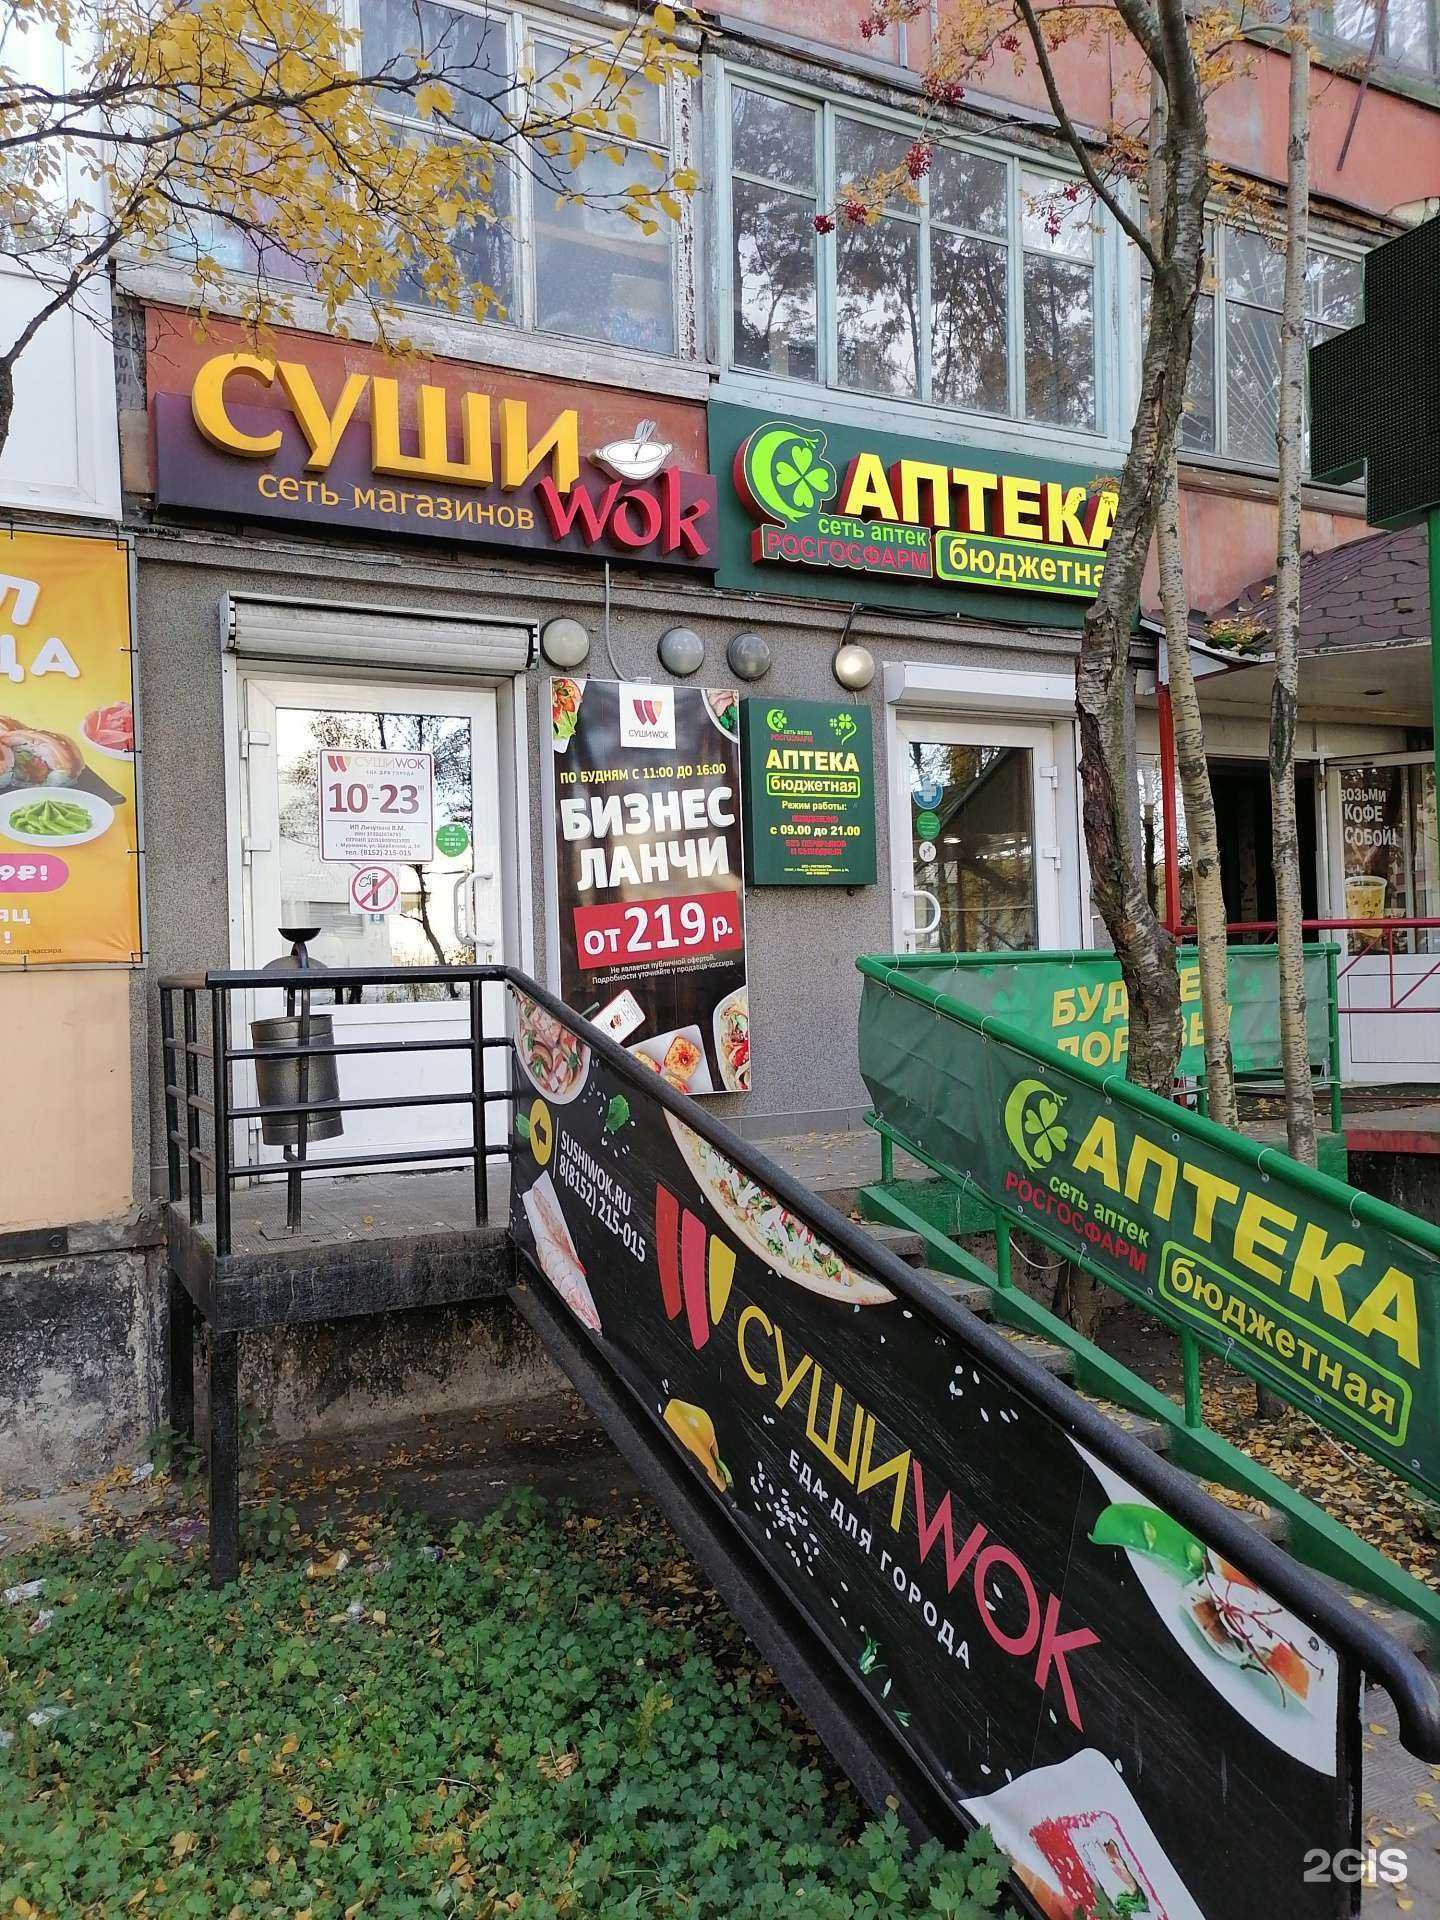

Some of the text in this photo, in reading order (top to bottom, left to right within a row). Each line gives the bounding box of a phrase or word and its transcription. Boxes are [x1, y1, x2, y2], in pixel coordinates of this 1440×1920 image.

[191, 353, 581, 494] СУШИ
[257, 469, 536, 531] сеть магазинов
[841, 452, 1120, 549] АПТЕКА
[766, 530, 930, 572] РОСГОСФАРМ
[817, 513, 928, 548] сеть аптек
[948, 538, 1106, 590] бюджетна
[560, 763, 727, 785] ПО БУДНЯМ С 11:00 ДО 16:00
[765, 748, 860, 773] АПТЕКА
[770, 775, 858, 794] бюджетная
[560, 786, 736, 842] БИЗНЕС
[769, 824, 861, 838] с 09.00 до 21.00
[782, 800, 848, 812] Режим работы:
[1344, 803, 1384, 825] КОФЕ
[576, 835, 730, 892] ЛАНЧИ
[624, 902, 706, 953] 219
[592, 971, 637, 985] Подробности
[637, 967, 671, 980] уточняйте
[610, 966, 620, 976] Не
[560, 1130, 632, 1216] SUSHIWOK.RU
[559, 1154, 646, 1263] 8(8152) 215-015
[1004, 1169, 1148, 1276] РОСГОСФАРМ
[1049, 1174, 1151, 1250] сеть аптек
[1072, 1114, 1421, 1369] АПТЕКА
[1169, 1257, 1396, 1427] бюджетная
[788, 1448, 971, 1670] ЕДА ДЛЯ ГОРОДА
